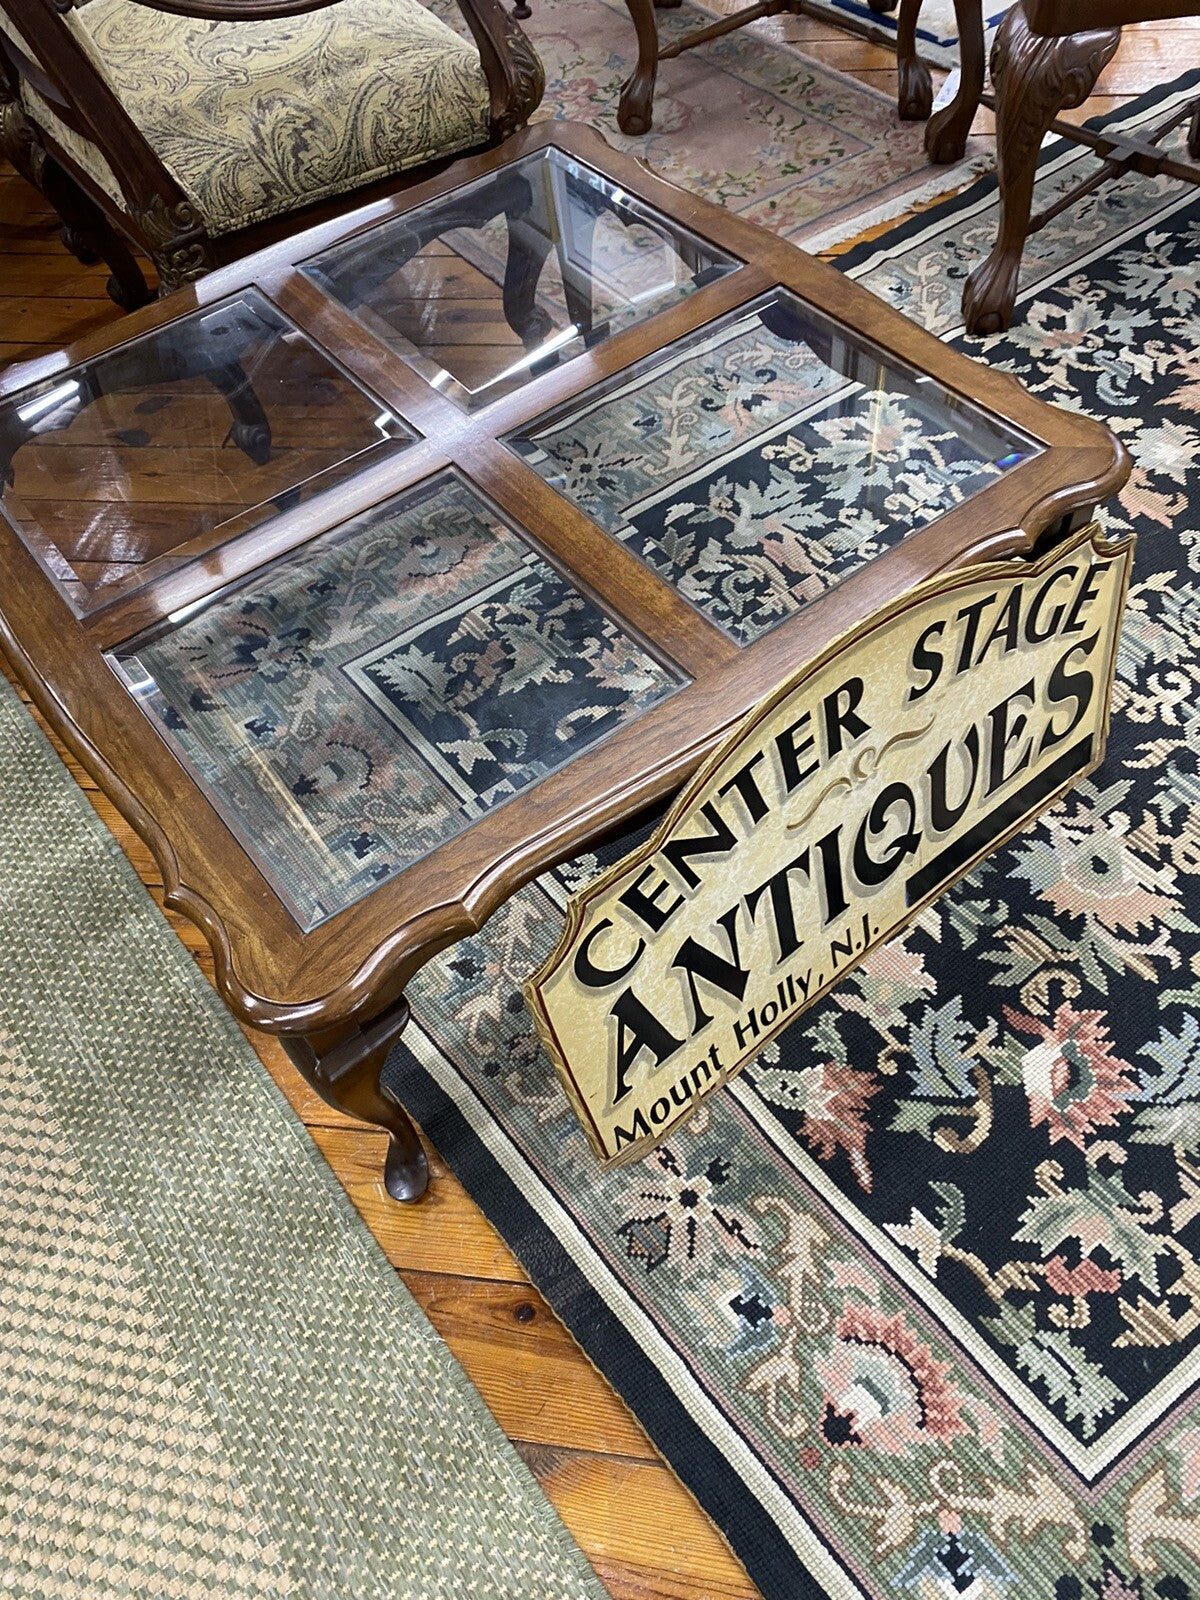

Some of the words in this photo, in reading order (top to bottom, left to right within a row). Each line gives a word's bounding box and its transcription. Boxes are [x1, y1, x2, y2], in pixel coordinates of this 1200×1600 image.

[574, 676, 872, 988] CENTER
[908, 561, 1114, 701] STAGE
[611, 626, 1101, 1105] ANTIQUES
[614, 1044, 724, 1150] Mount
[733, 968, 824, 1049] Holly,
[830, 914, 880, 969] N.J.
